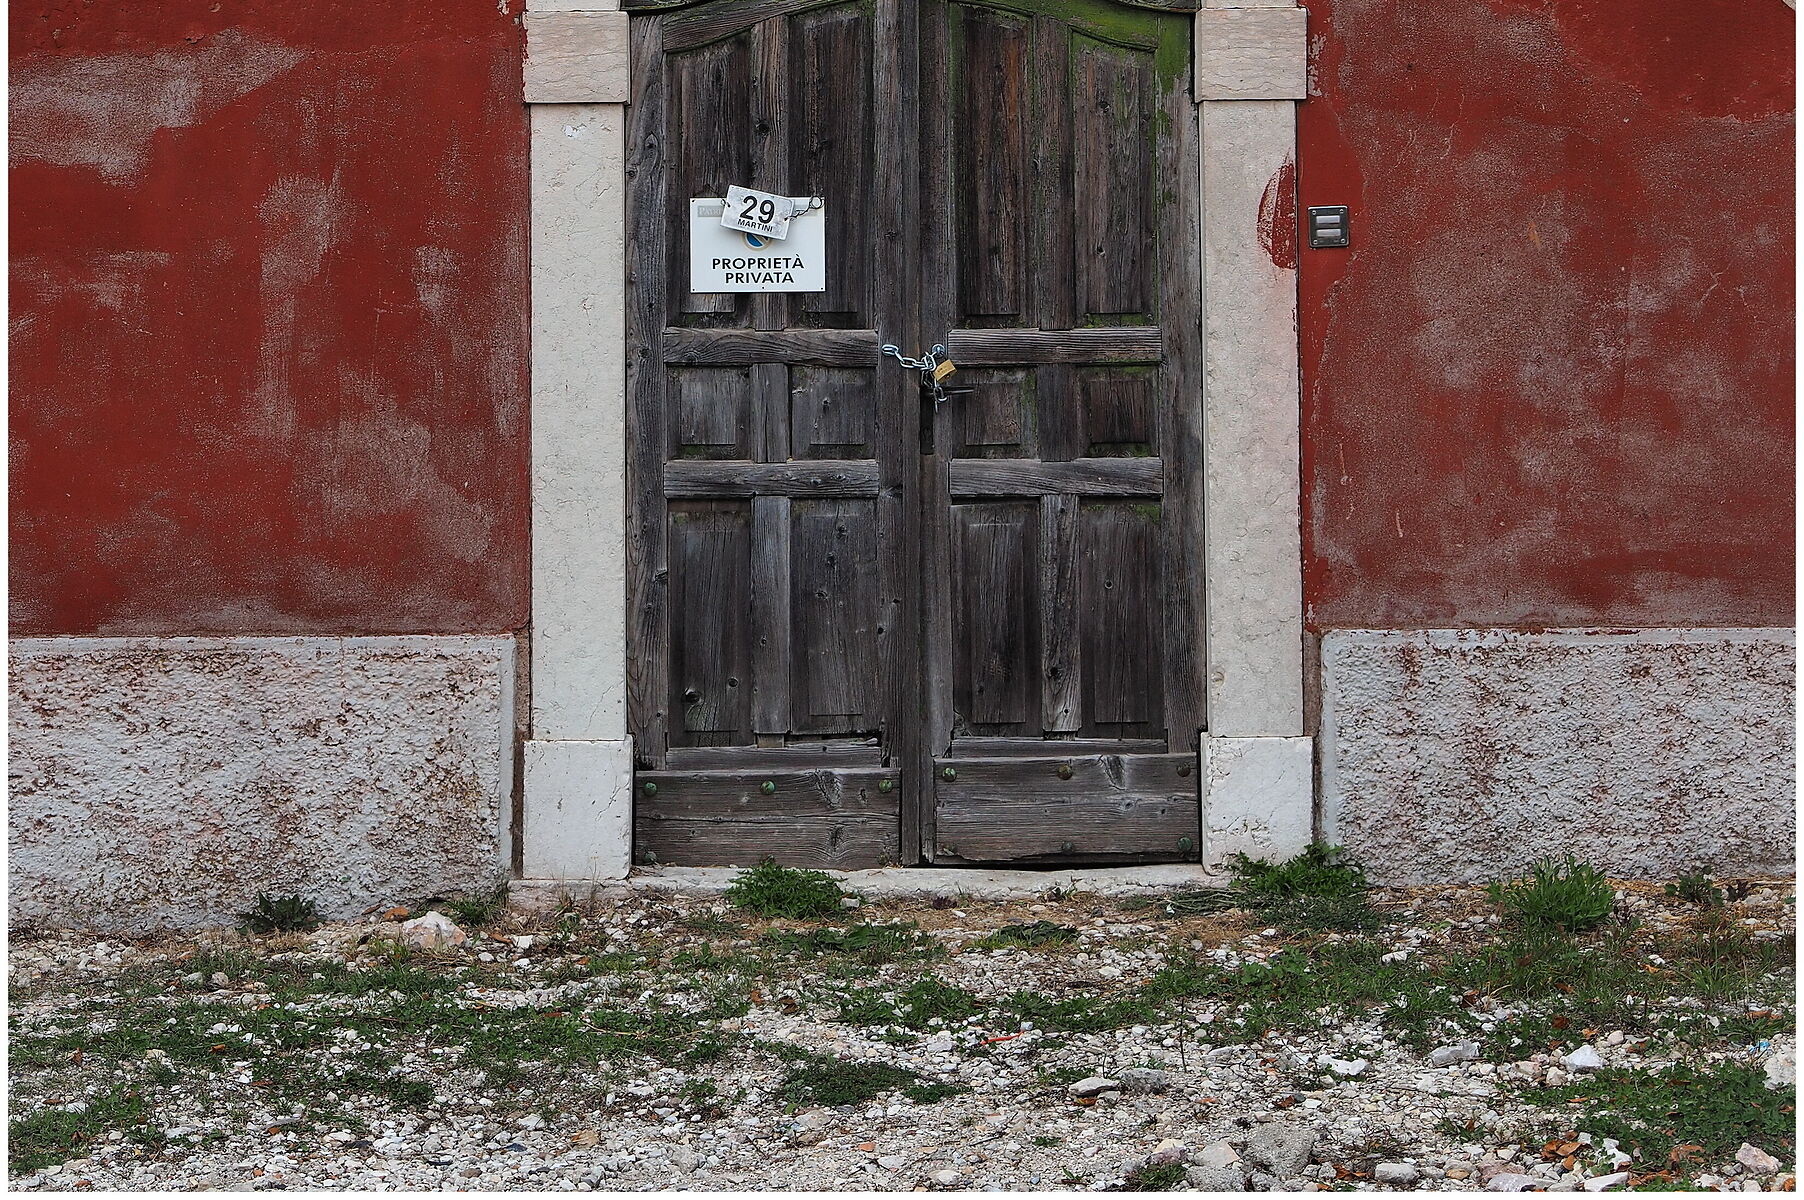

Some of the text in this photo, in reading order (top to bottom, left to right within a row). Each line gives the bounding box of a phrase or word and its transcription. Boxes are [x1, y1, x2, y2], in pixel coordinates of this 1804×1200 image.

[739, 195, 776, 225] 29
[736, 218, 774, 233] MARTINI
[712, 254, 805, 270] PROPRIETÀ
[725, 272, 795, 284] PRIVATA
